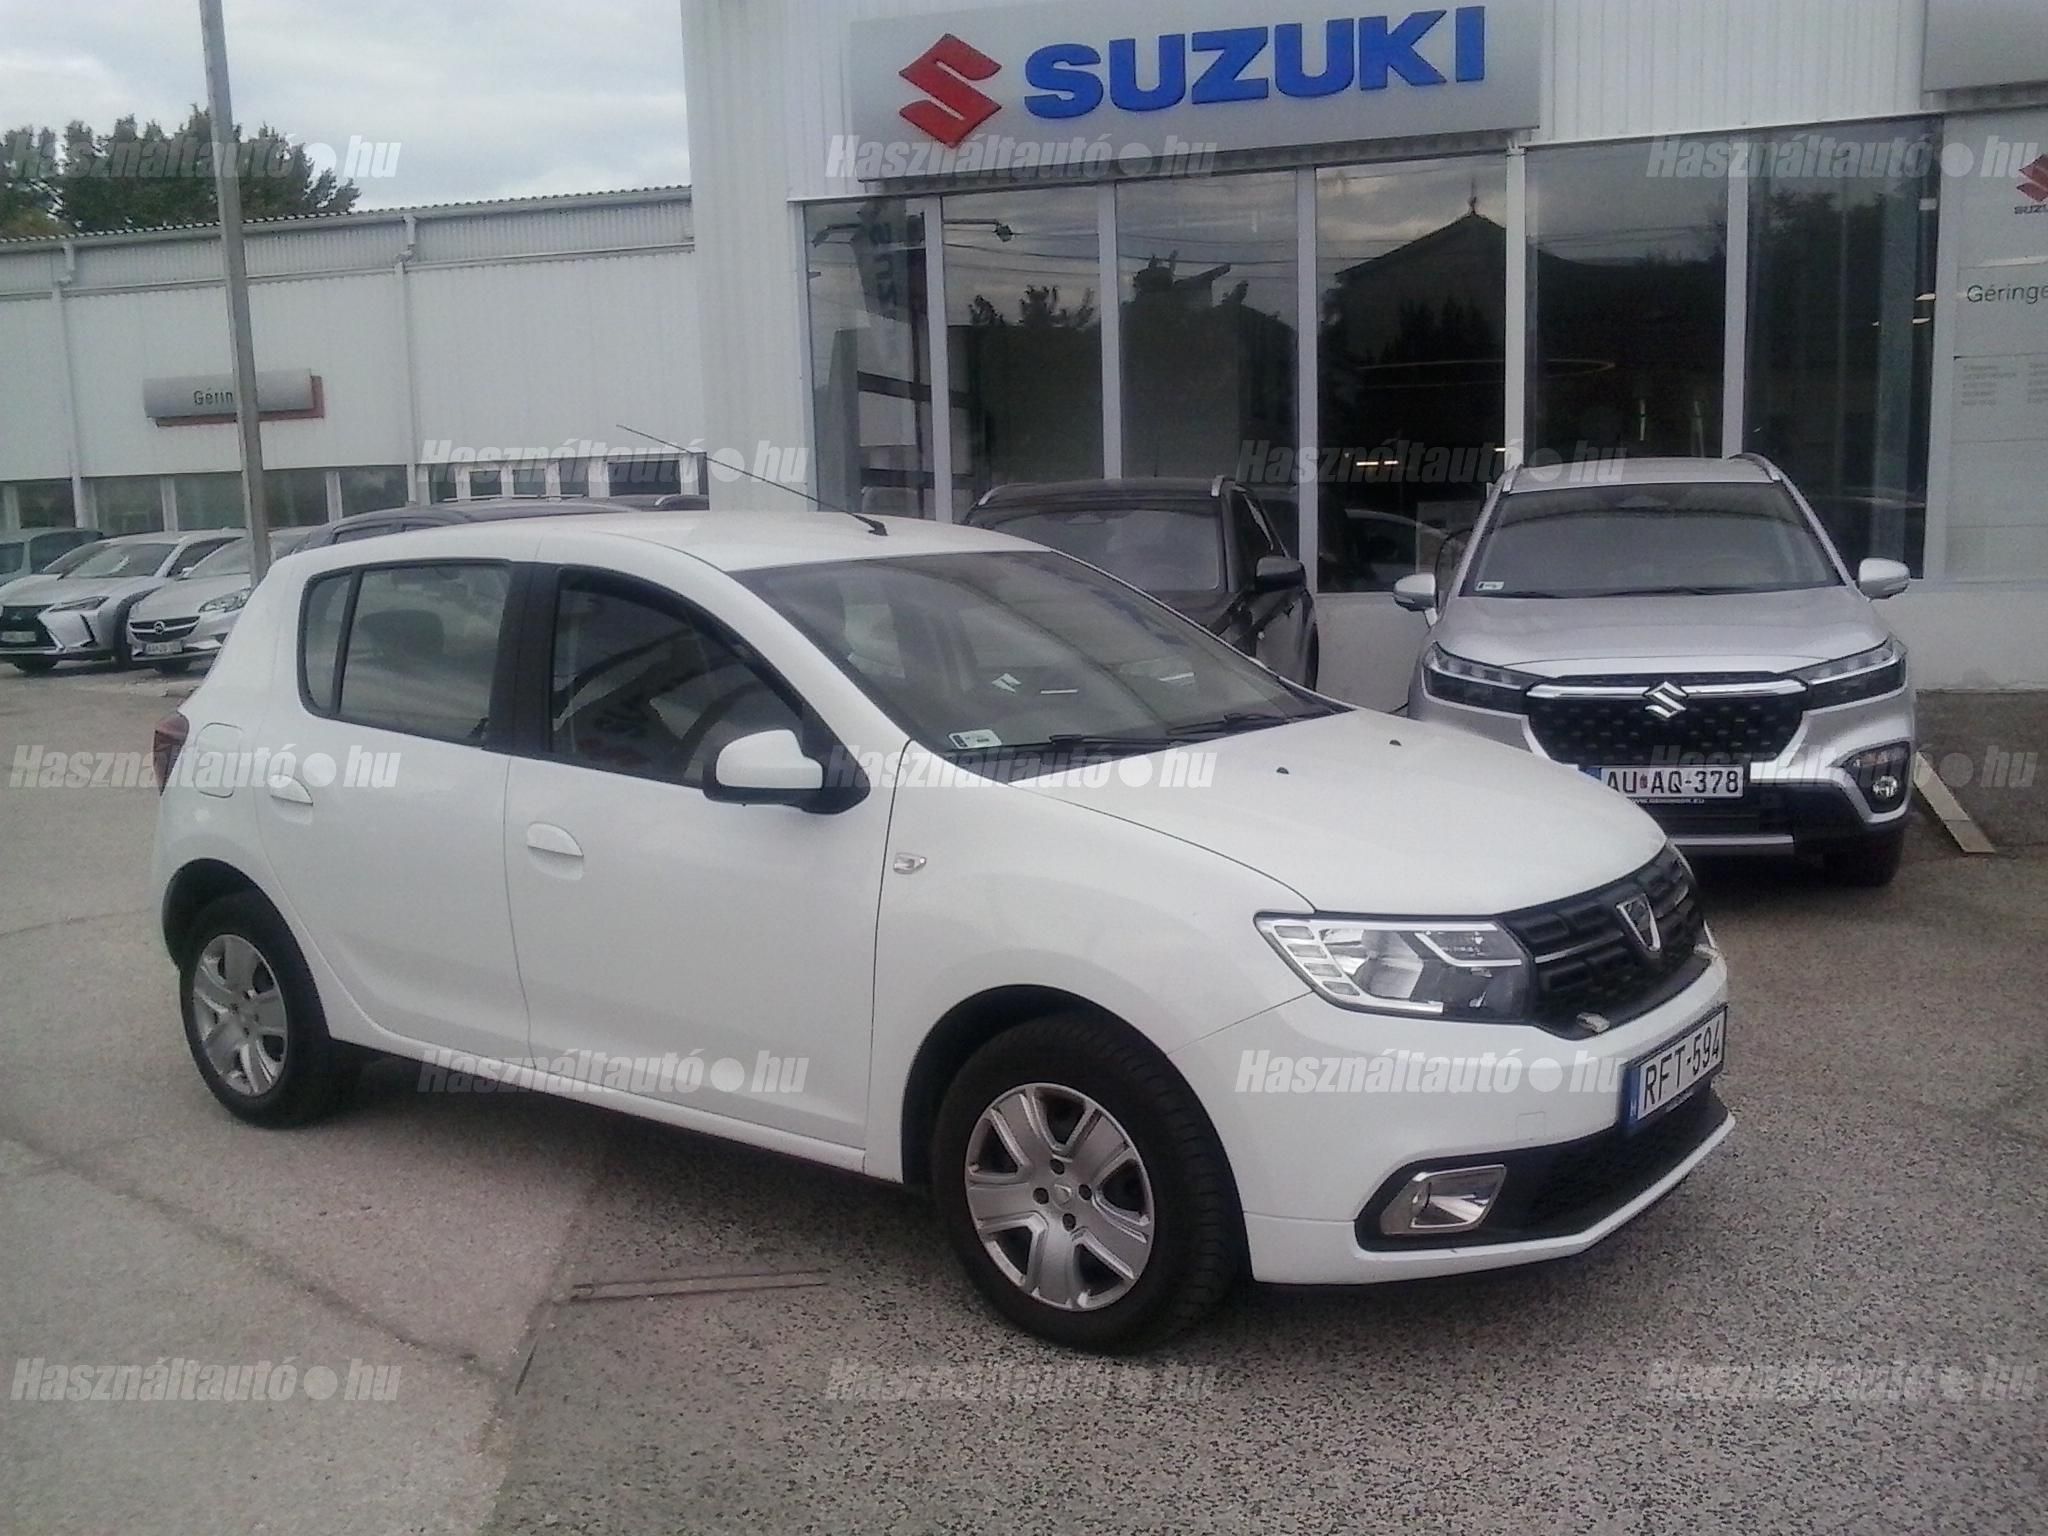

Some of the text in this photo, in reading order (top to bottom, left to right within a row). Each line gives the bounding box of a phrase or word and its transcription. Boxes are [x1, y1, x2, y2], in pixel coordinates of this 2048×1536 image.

[1023, 5, 1486, 119] SUZUKI
[193, 387, 234, 405] Gérin
[1644, 1020, 1720, 1110] RFT-594
